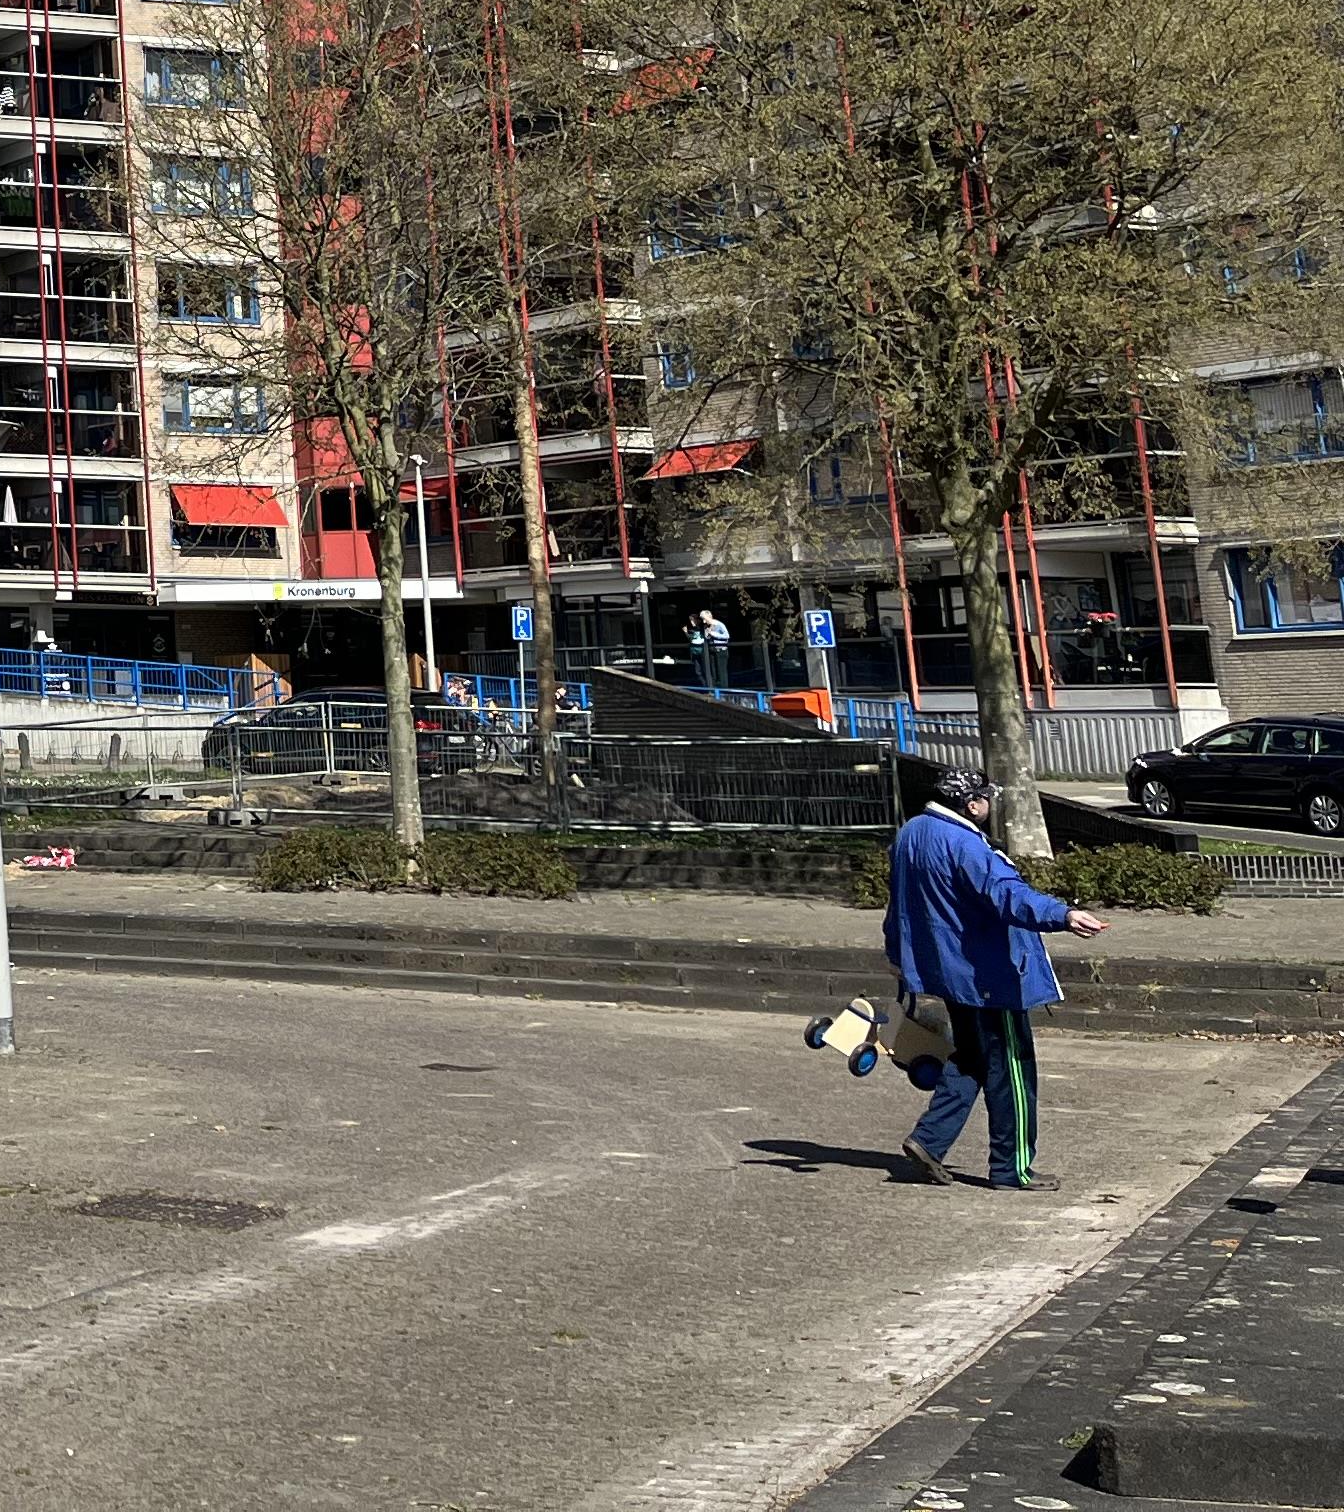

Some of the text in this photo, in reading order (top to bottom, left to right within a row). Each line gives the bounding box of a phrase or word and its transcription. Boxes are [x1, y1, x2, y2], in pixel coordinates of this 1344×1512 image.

[287, 585, 356, 598] Kronenburg
[517, 609, 528, 626] P
[810, 613, 825, 632] P
